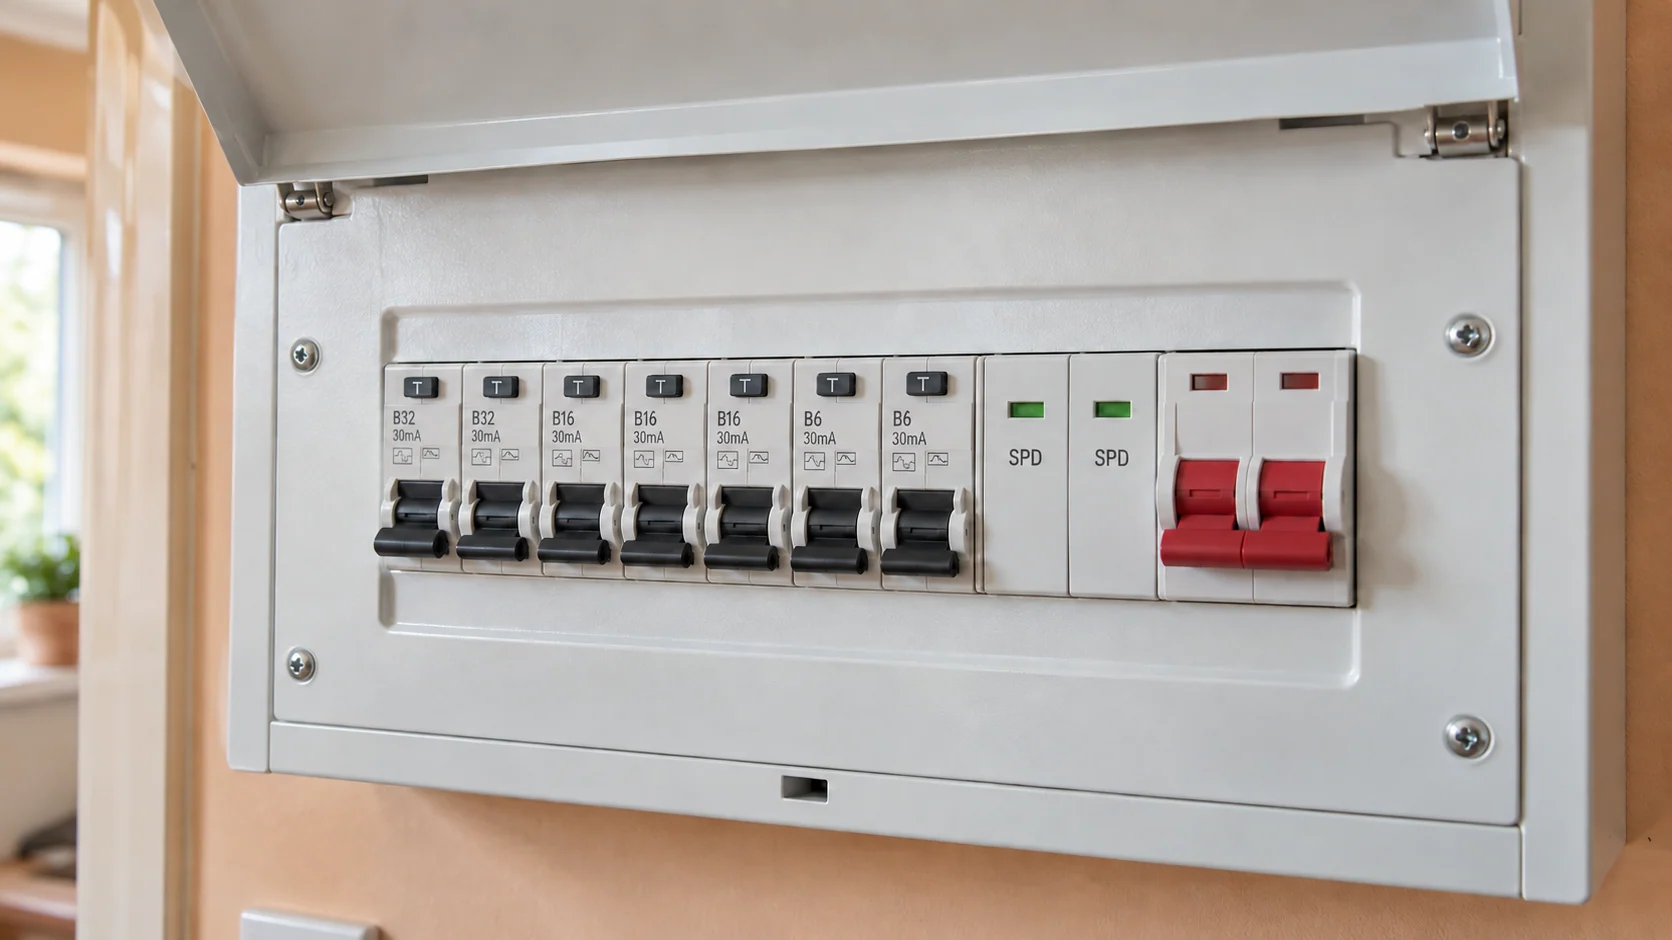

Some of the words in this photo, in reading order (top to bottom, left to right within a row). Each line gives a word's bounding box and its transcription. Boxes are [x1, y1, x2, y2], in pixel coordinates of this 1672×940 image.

[412, 382, 423, 394] T
[491, 381, 503, 394] T
[572, 381, 584, 394] T
[655, 380, 666, 394] T
[739, 379, 752, 392] T
[826, 378, 839, 392] T
[916, 377, 930, 391] T
[393, 410, 416, 426] B32
[471, 409, 495, 426] B32
[552, 410, 575, 427] B16
[634, 410, 658, 427] B16
[717, 410, 741, 427] B16
[804, 410, 823, 427] B6
[893, 409, 912, 427] B6
[392, 429, 422, 442] 30mA
[471, 430, 501, 443] 30mA
[551, 430, 583, 444] 30mA
[633, 431, 665, 444] 30mA
[716, 431, 750, 445] 30mA
[803, 431, 837, 446] 30mA
[892, 432, 927, 446] 30mA
[1008, 449, 1043, 467] SPD
[1094, 449, 1129, 467] SPD
